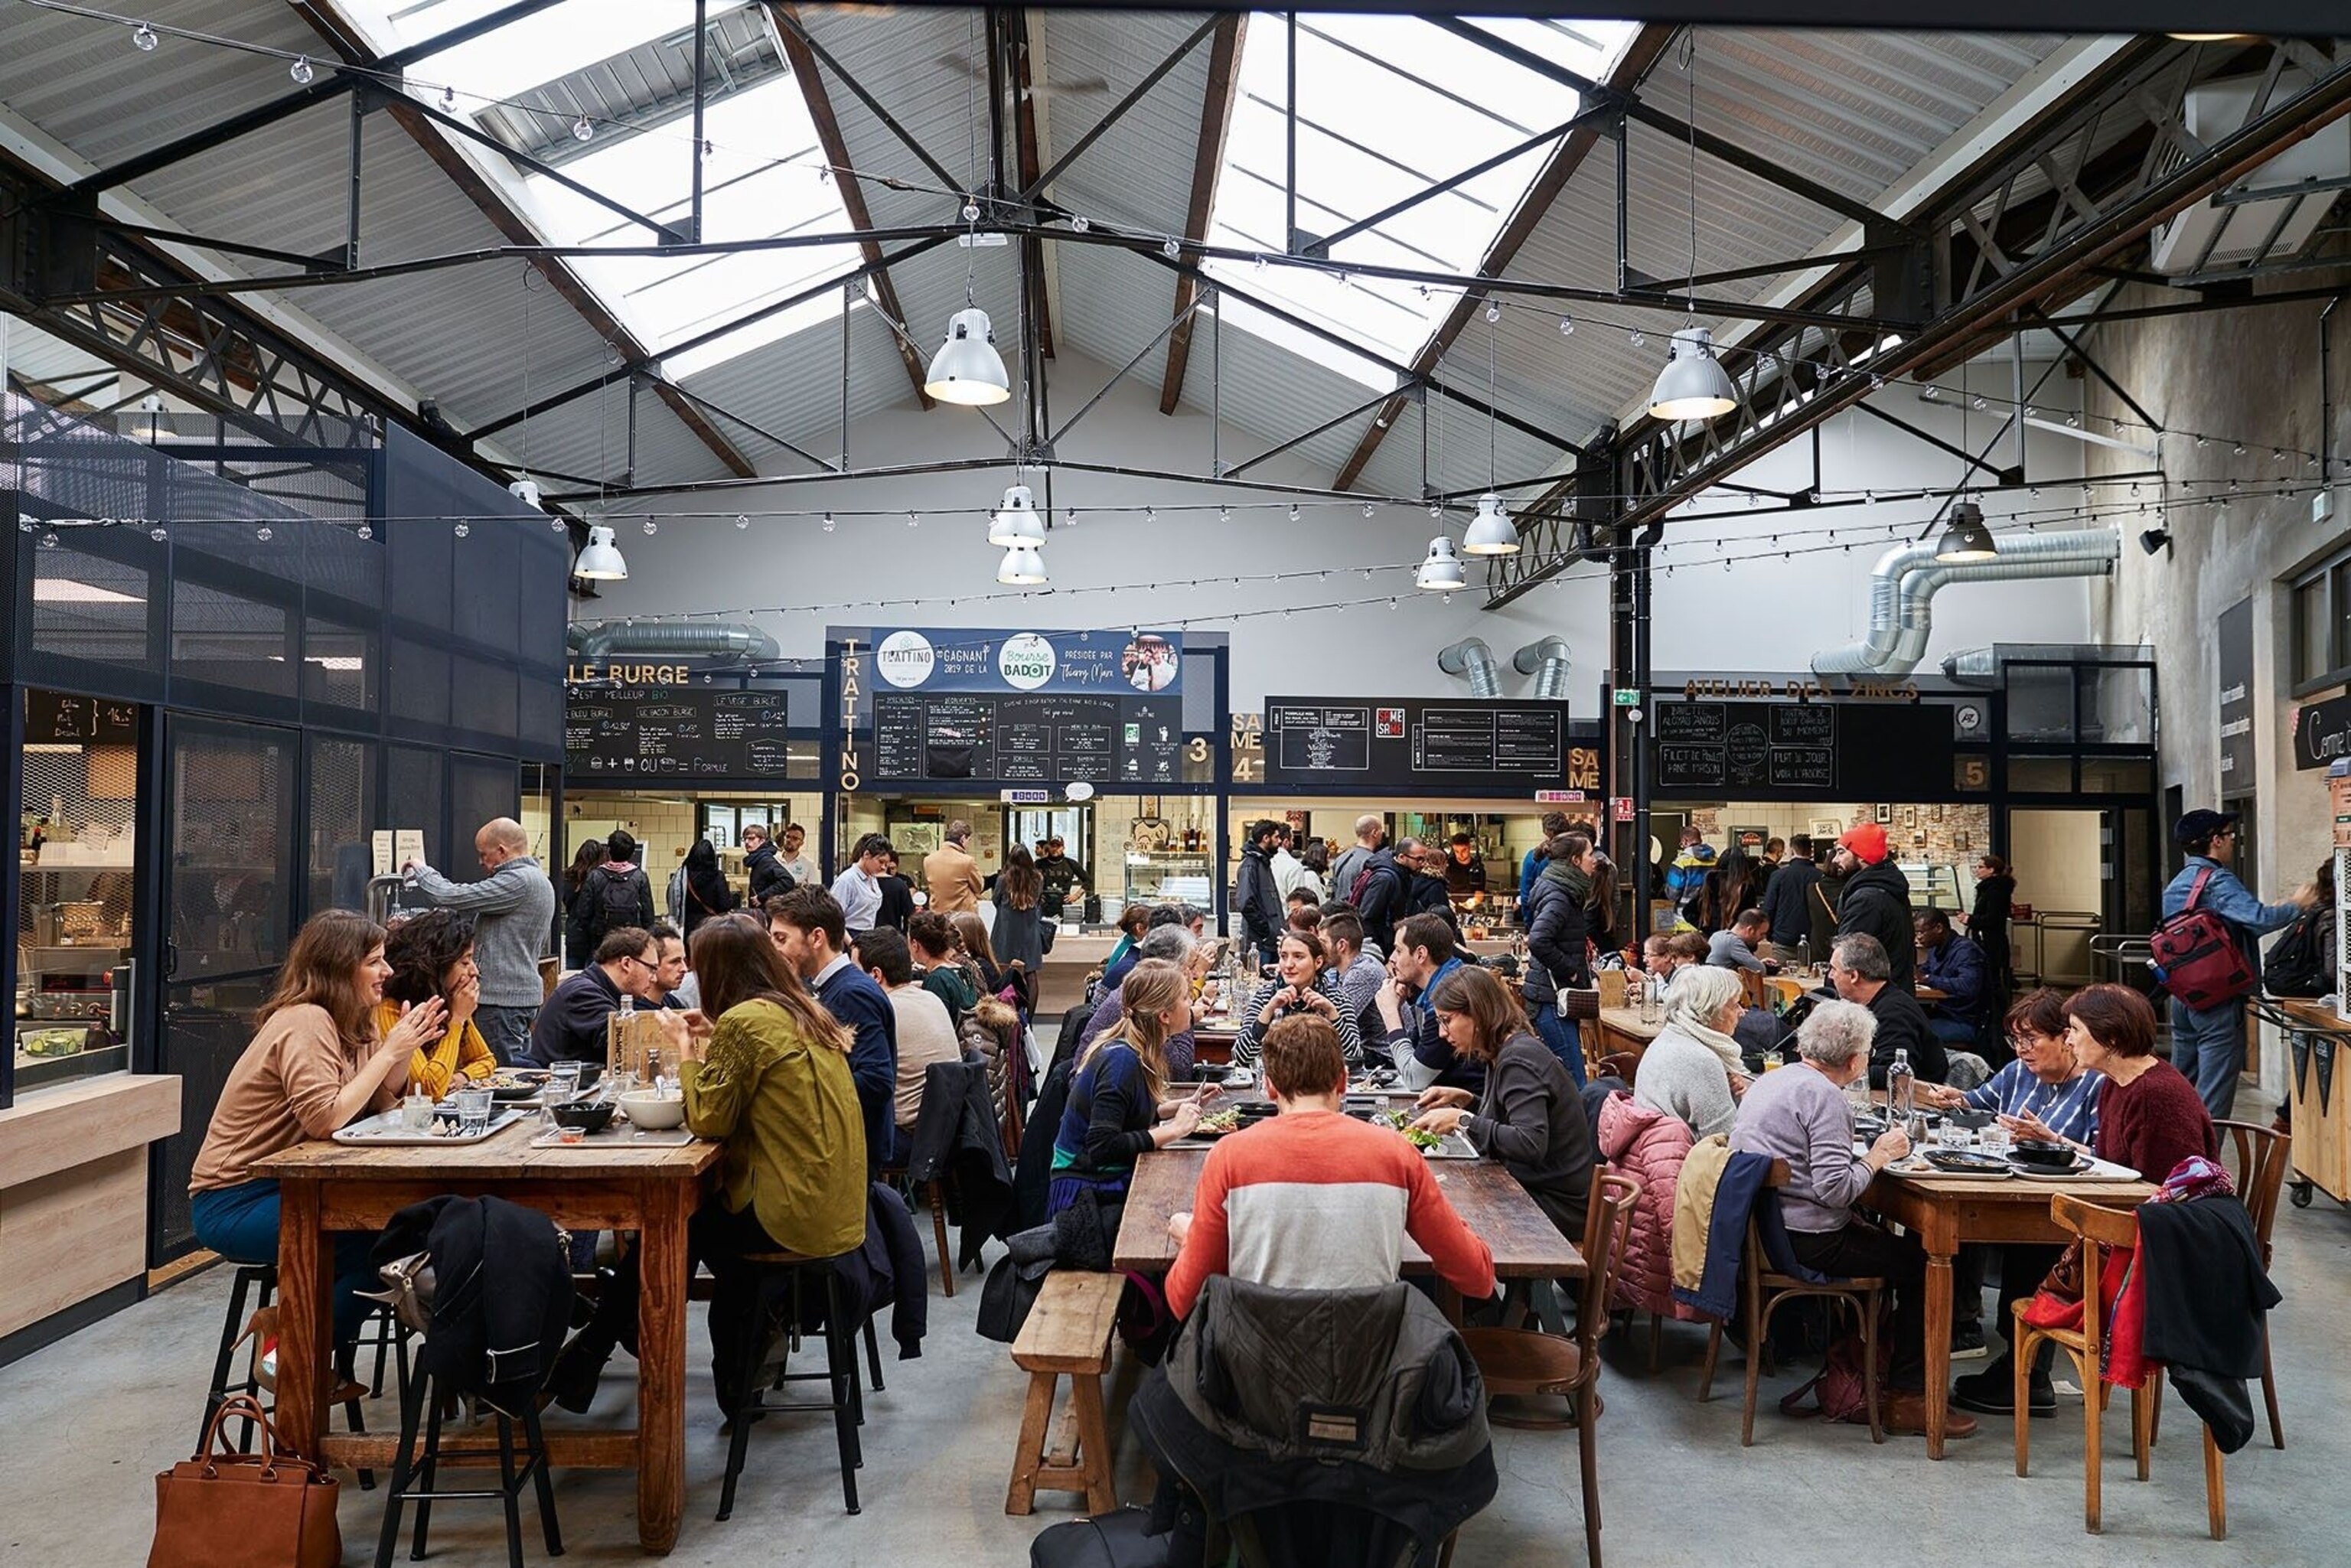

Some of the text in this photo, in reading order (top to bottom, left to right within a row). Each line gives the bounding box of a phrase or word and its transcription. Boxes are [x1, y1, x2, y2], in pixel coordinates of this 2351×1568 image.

[944, 650, 988, 663] GAGNANT
[1006, 650, 1049, 661] Bourse
[1101, 650, 1114, 660] PAR
[568, 664, 689, 684] LE BURGE
[944, 664, 988, 674] 2019 DE LA
[1004, 663, 1052, 678] BADOIT
[605, 690, 645, 699] MEILLEUR
[1684, 680, 1918, 700] ATELIER DES ZINCS
[841, 638, 859, 791] TRATTINO
[1232, 713, 1261, 731] SA
[1379, 710, 1403, 722] SAME
[1378, 723, 1403, 735] SAME
[1231, 732, 1262, 749] ME
[1189, 737, 1208, 762] 3
[641, 758, 657, 772] OU
[1571, 748, 1599, 770] SA
[1234, 757, 1253, 781] 4
[1966, 761, 1984, 785] 5
[1569, 771, 1600, 789] ME
